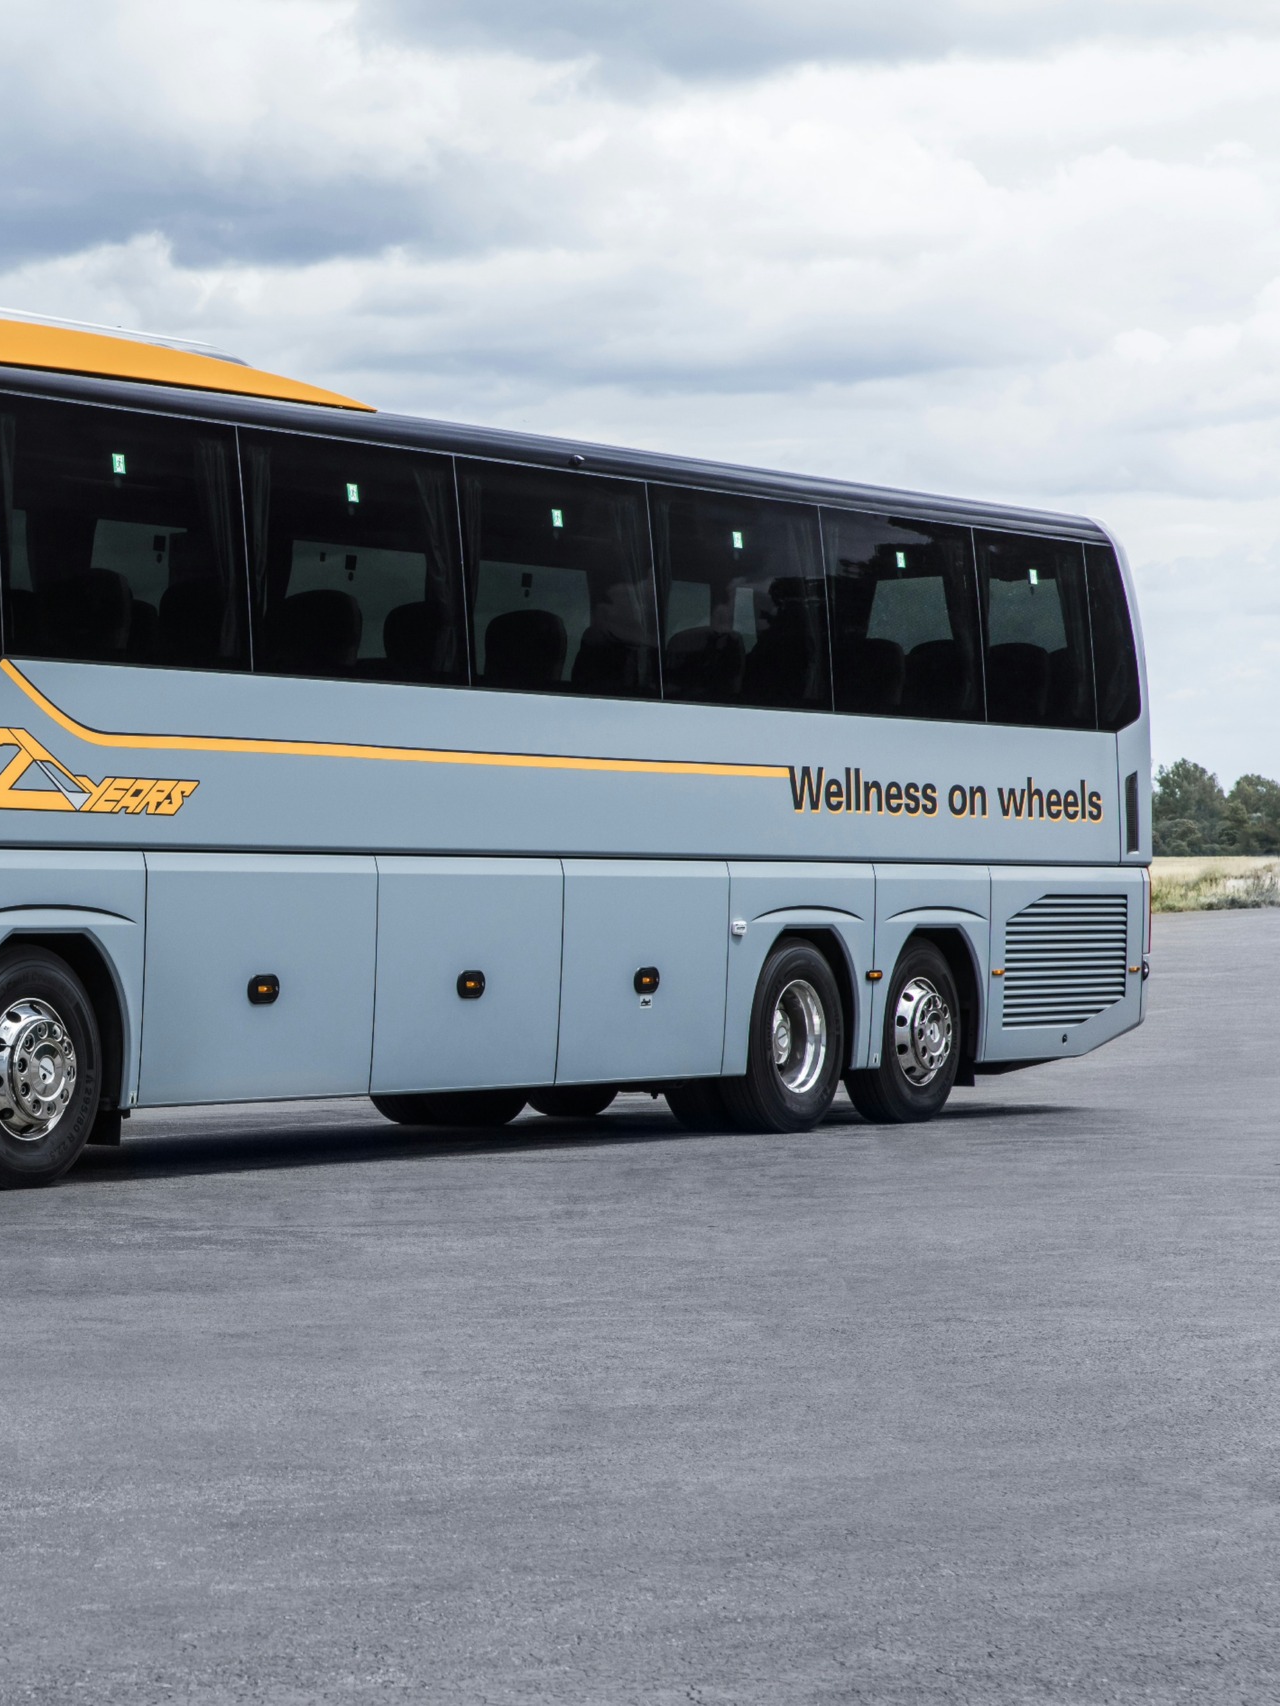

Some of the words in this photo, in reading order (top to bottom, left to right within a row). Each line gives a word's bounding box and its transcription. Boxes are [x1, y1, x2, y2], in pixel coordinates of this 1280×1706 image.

[75, 775, 200, 816] YEARS
[788, 765, 938, 816] Wellness
[948, 784, 988, 818] on
[997, 776, 1104, 822] wheels
